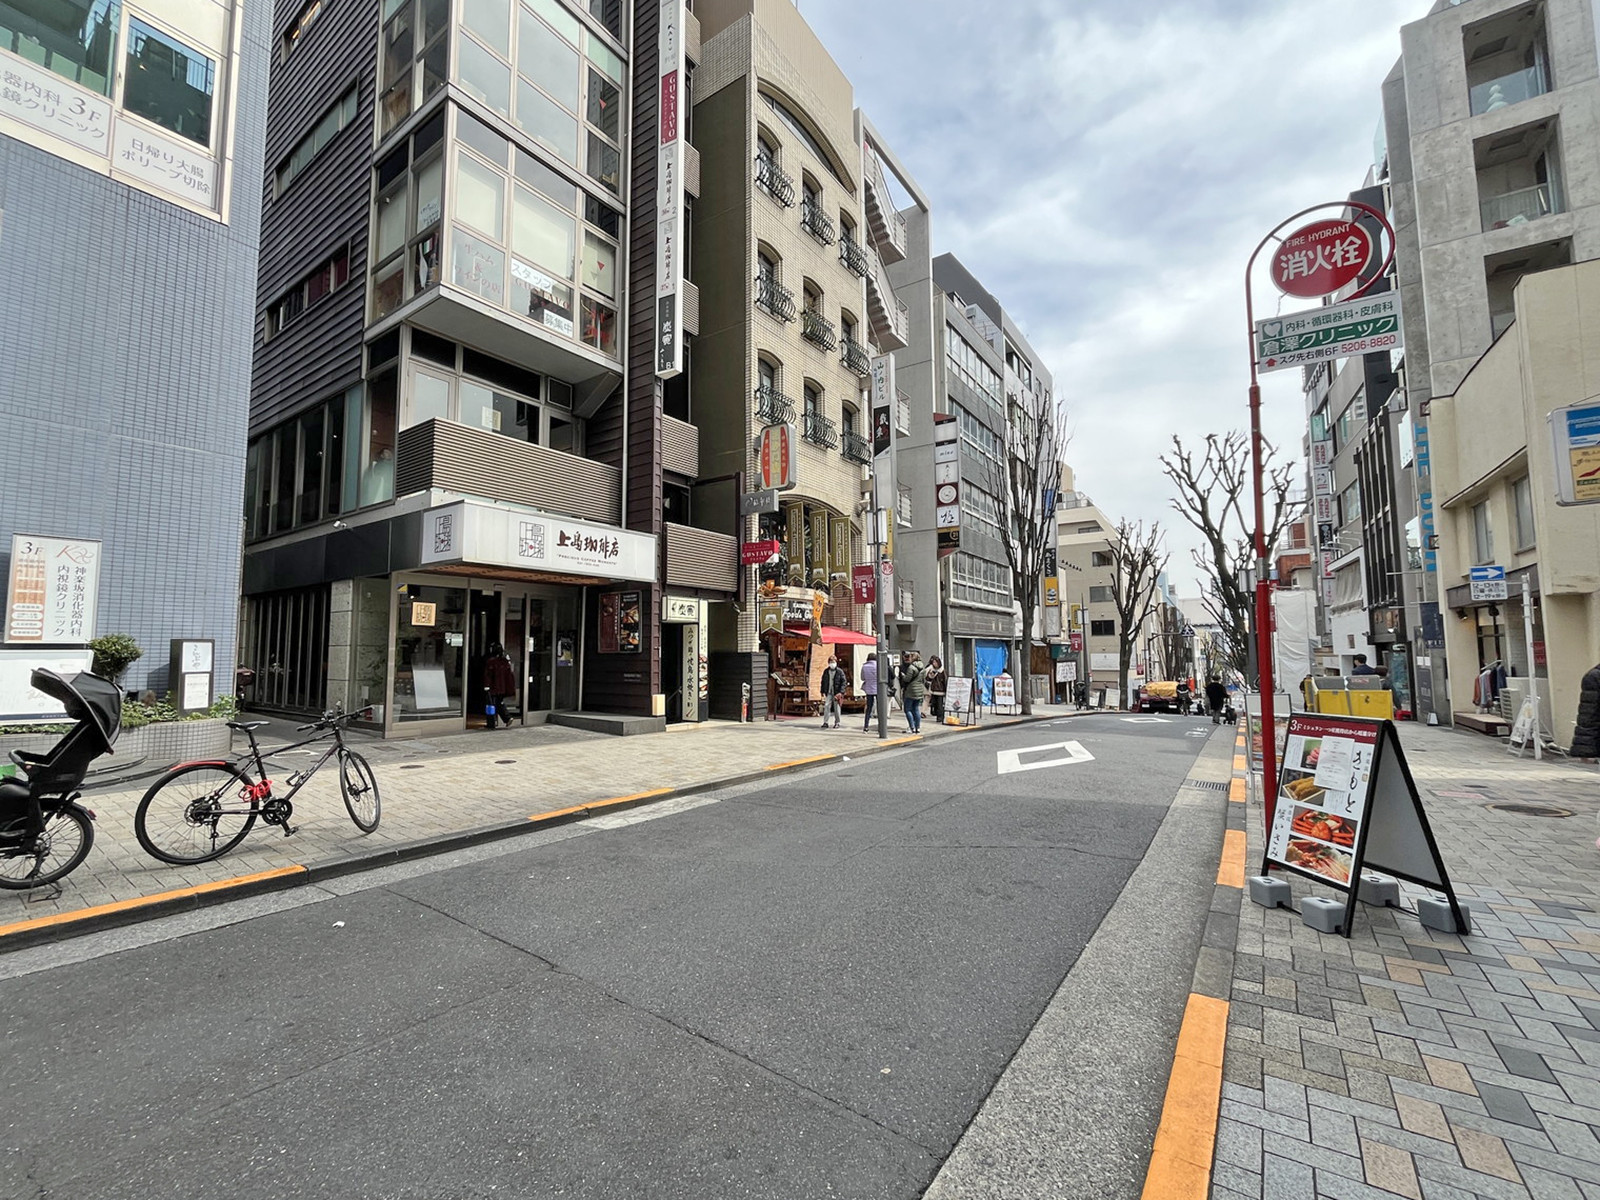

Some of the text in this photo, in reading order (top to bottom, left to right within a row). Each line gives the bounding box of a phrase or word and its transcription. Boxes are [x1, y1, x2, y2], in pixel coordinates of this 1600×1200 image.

[69, 96, 102, 122] 3F
[131, 138, 205, 180] 日帰り大腸
[1286, 223, 1352, 248] FIRE HYDRANT
[1280, 235, 1363, 282] 消火栓
[512, 263, 552, 289] スタッフ
[545, 313, 573, 334] 募集中
[1285, 301, 1394, 333] 内科・循環器科・皮膚科
[1262, 316, 1396, 356] 倉澤クリニック
[1341, 334, 1397, 354] 5206-8820
[20, 541, 44, 556] 3F
[556, 529, 620, 559] 上島珈琲店
[1289, 719, 1303, 731] 3F
